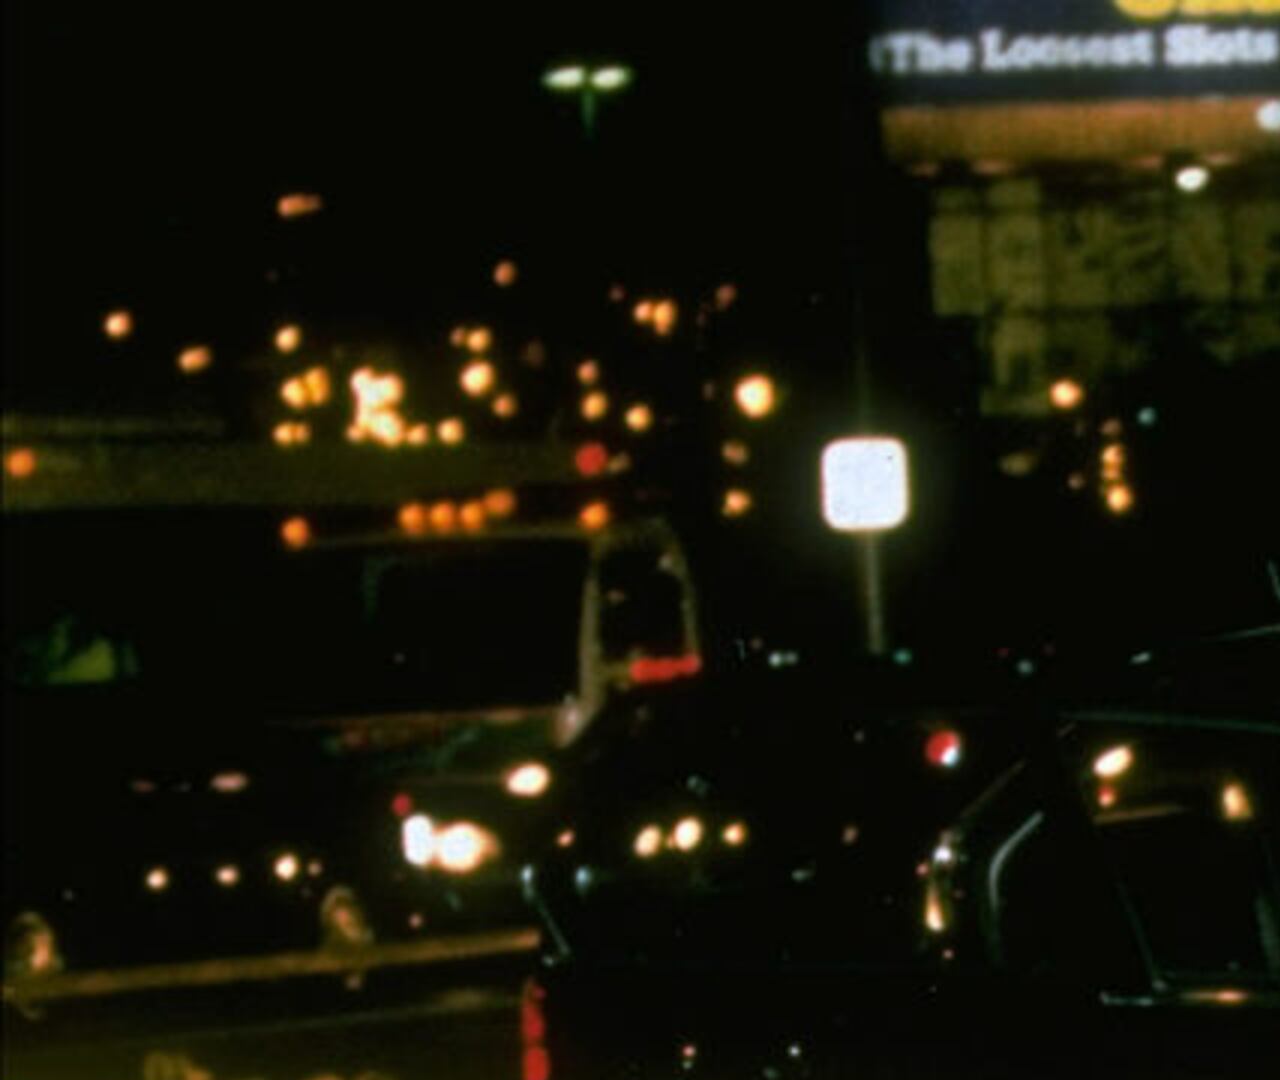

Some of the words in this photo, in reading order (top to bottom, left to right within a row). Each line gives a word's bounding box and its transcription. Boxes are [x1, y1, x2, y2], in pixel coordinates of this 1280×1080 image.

[868, 29, 972, 74] (The
[978, 27, 1156, 72] Loosest
[1163, 23, 1280, 67] Slots
